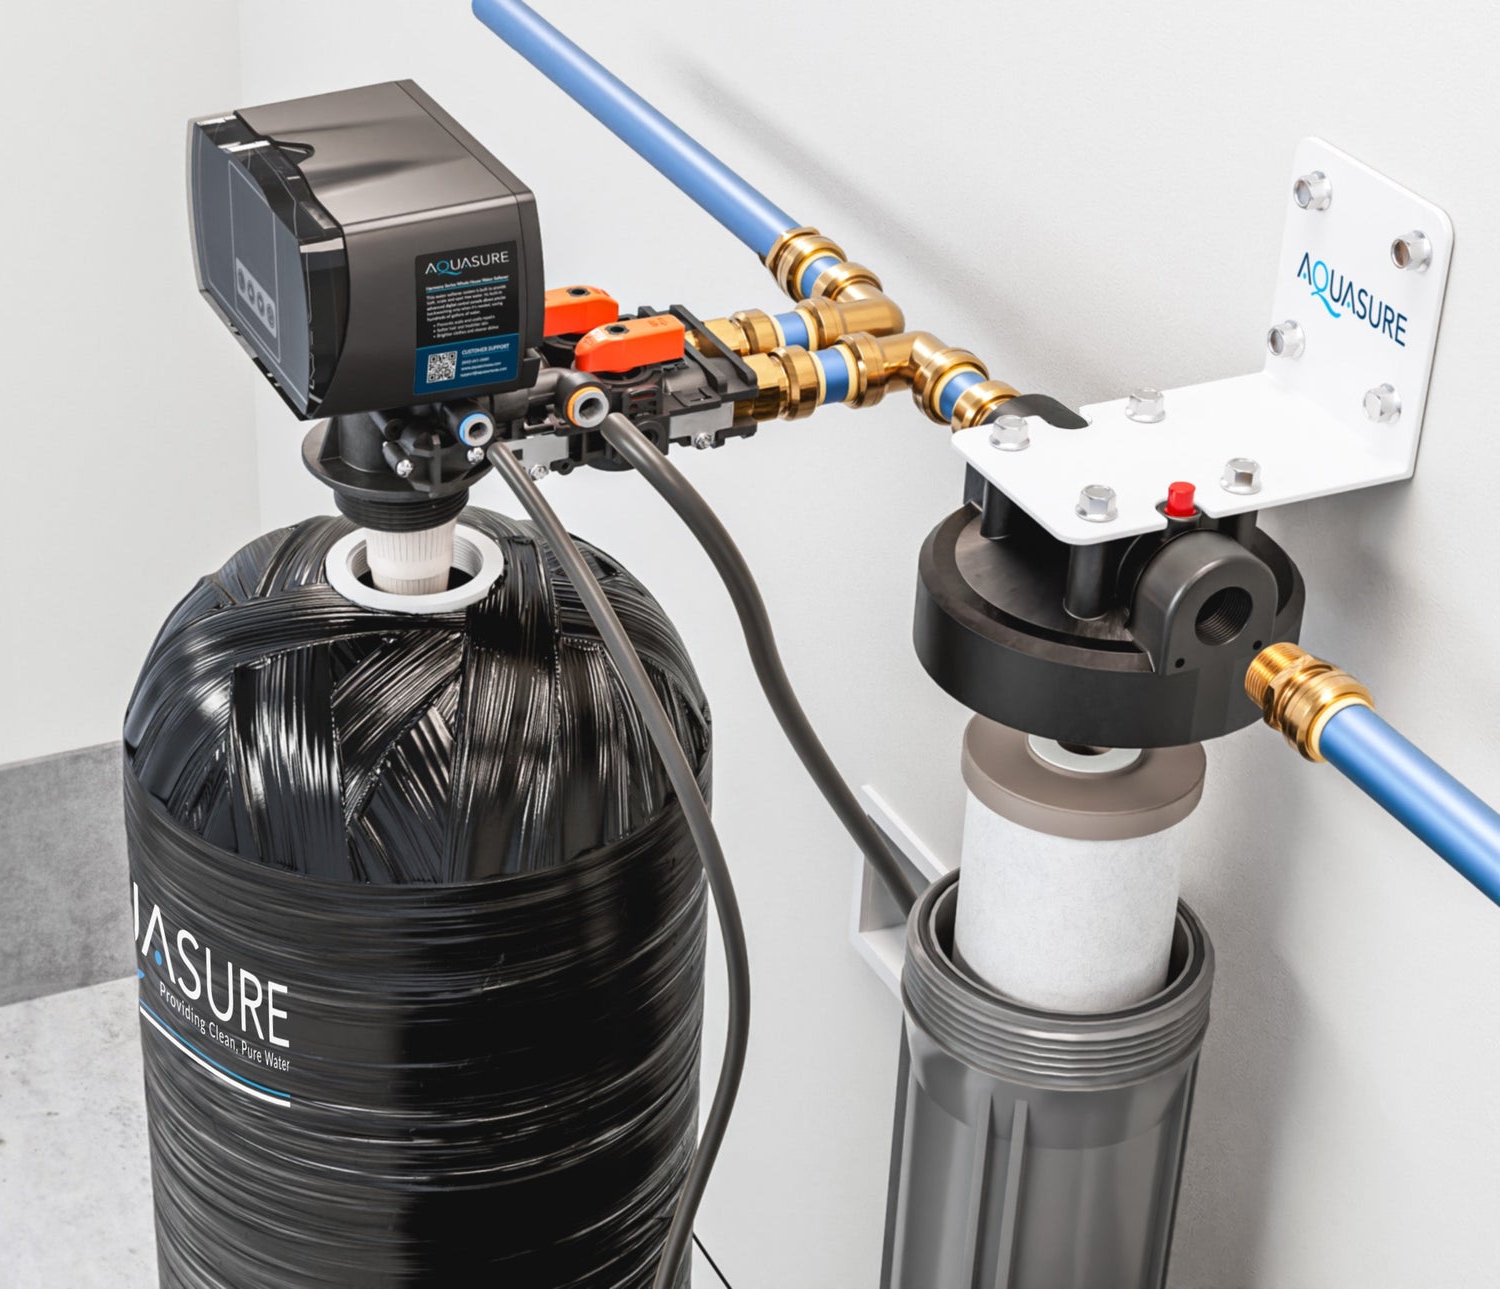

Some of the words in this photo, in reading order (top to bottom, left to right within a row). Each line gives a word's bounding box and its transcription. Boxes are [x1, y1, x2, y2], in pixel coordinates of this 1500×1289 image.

[425, 251, 509, 276] AQUASURE
[1297, 252, 1408, 347] AQUASURE
[159, 981, 206, 1034] Providing
[208, 1022, 239, 1055] Clean,
[241, 1040, 262, 1063] Pure
[264, 1050, 291, 1073] Water
